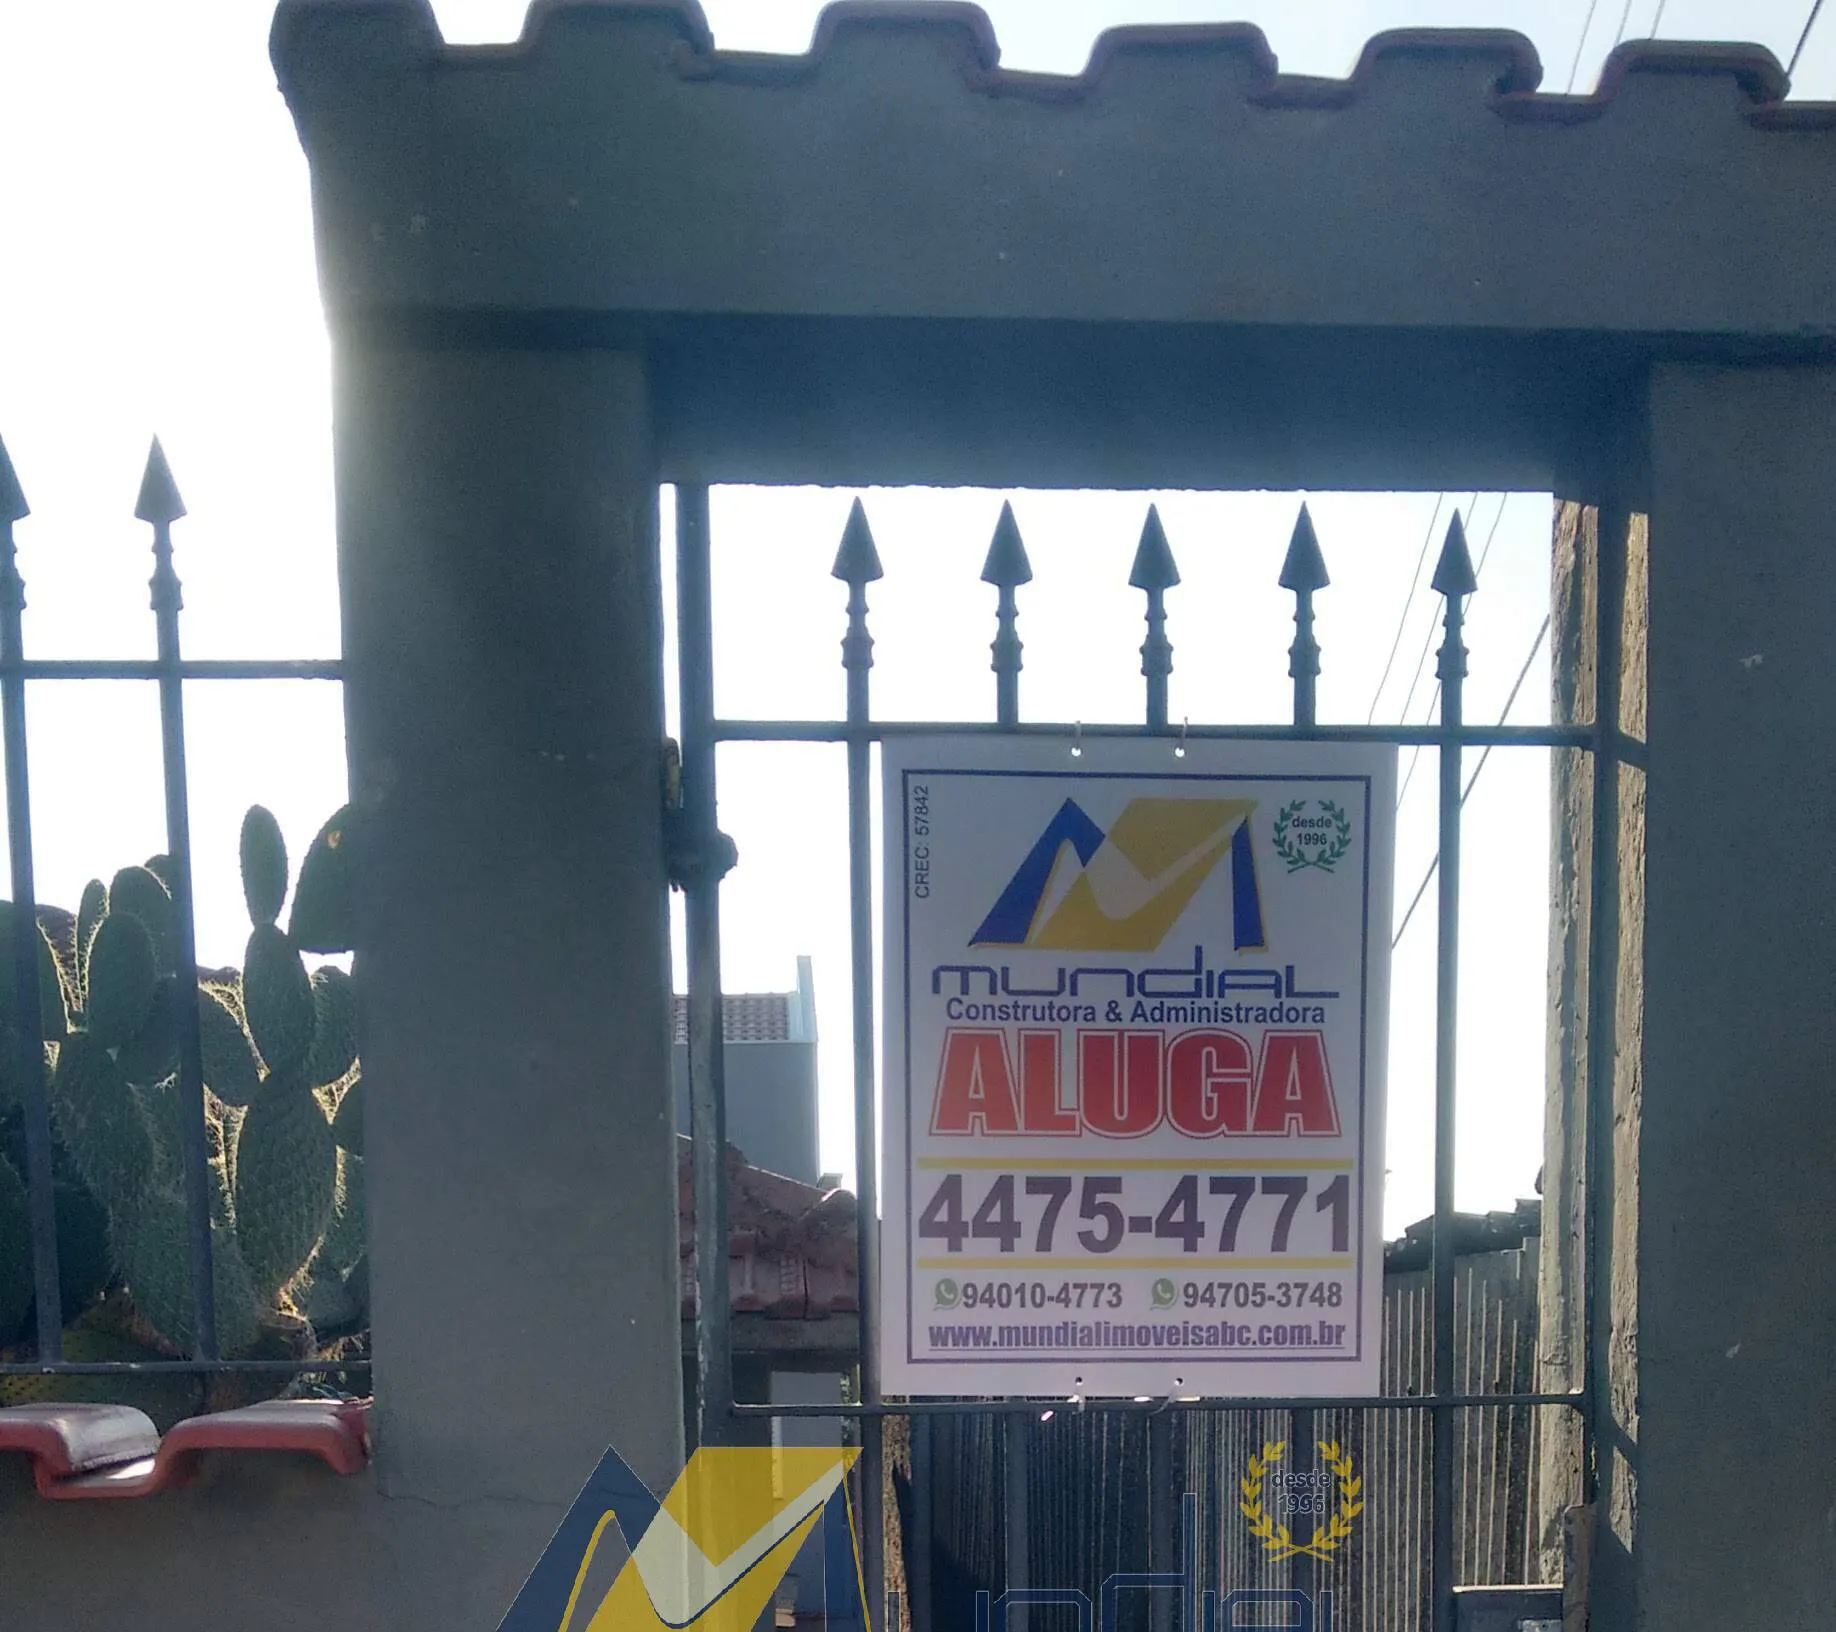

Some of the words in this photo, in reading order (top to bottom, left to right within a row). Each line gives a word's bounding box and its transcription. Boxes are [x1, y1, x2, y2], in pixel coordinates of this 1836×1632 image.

[913, 783, 930, 837] 57842
[1291, 814, 1333, 829] desde
[1296, 832, 1328, 846] 1996
[914, 841, 930, 899] CREC:
[946, 997, 1097, 1023] Construtora
[1105, 1000, 1123, 1023] &
[1130, 1000, 1326, 1024] Administradora
[928, 1026, 1342, 1139] ALUGA
[918, 1173, 1351, 1254] 4475-4771
[961, 1281, 1123, 1310] 94010-4773
[1182, 1281, 1343, 1309] 94705-3748
[928, 1320, 1347, 1350] www.mundialimoveisabc.com.br
